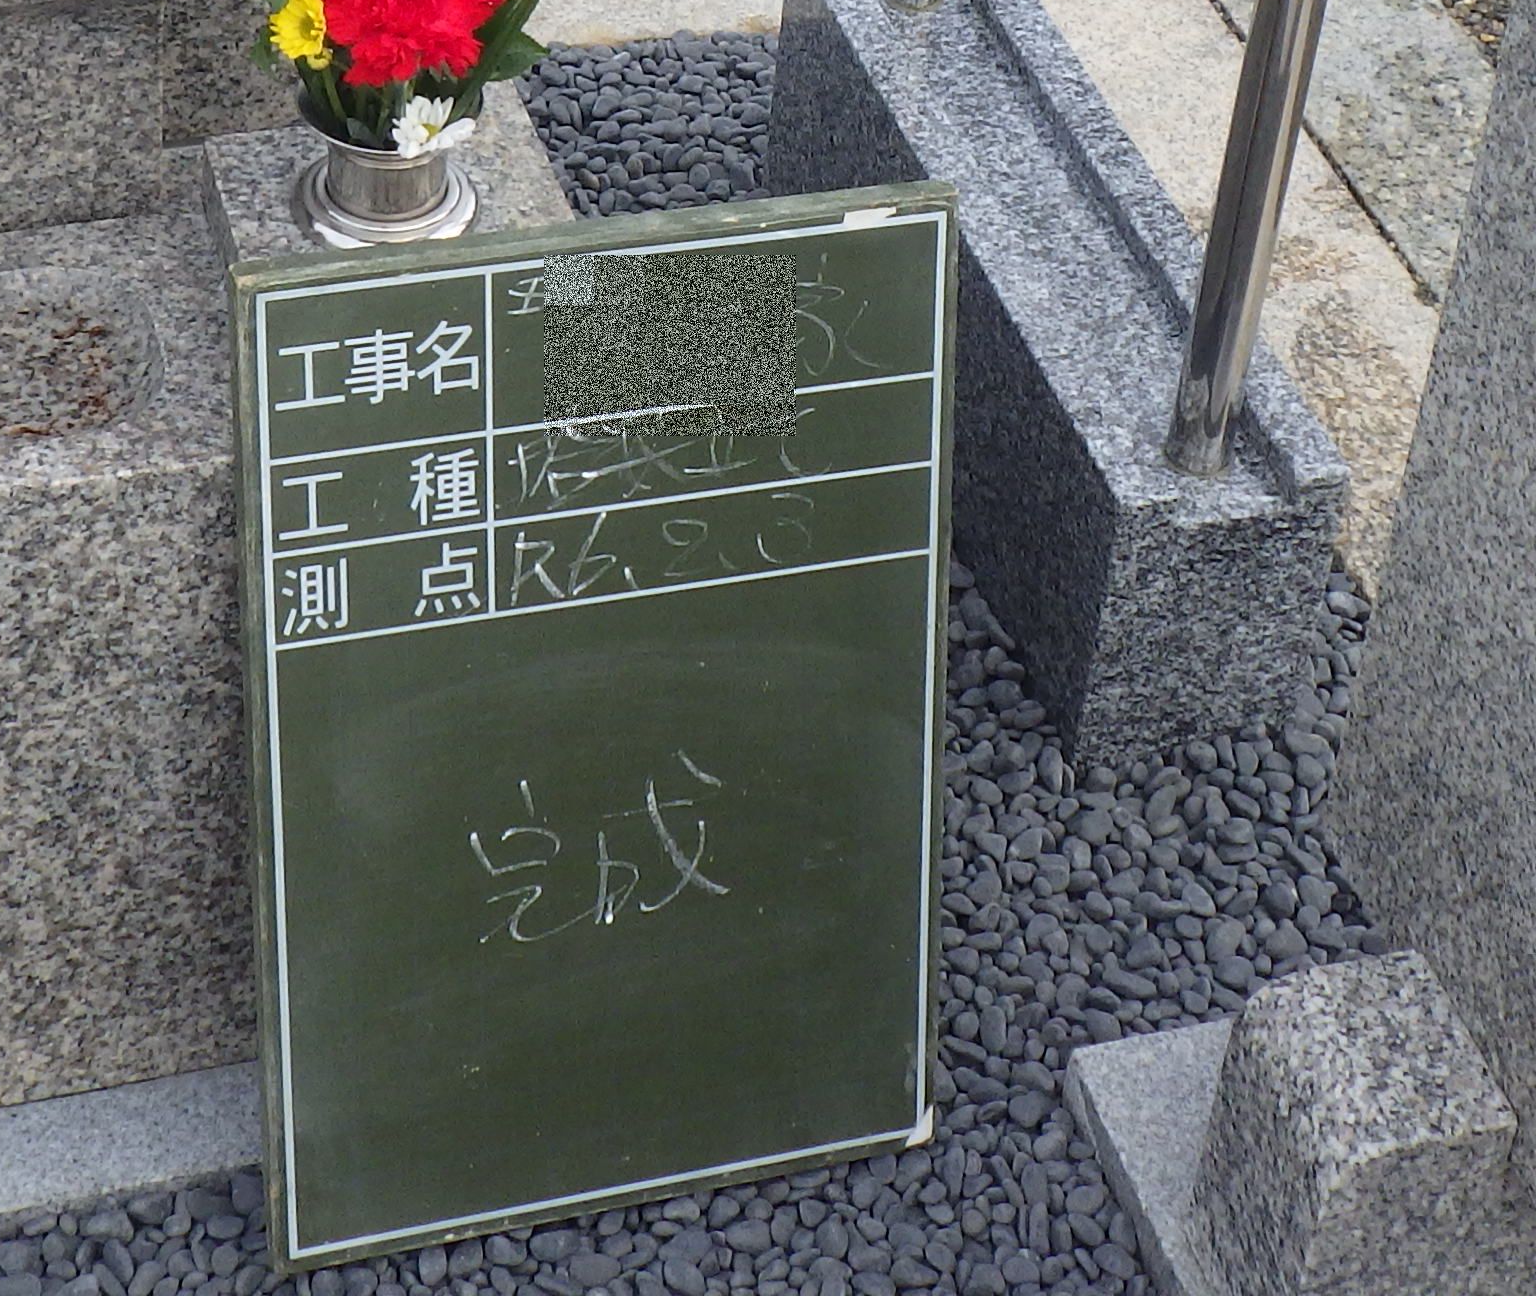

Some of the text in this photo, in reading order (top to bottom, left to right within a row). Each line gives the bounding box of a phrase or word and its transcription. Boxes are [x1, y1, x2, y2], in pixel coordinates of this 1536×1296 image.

[274, 320, 481, 413] 工事名
[468, 748, 732, 944] 完成
